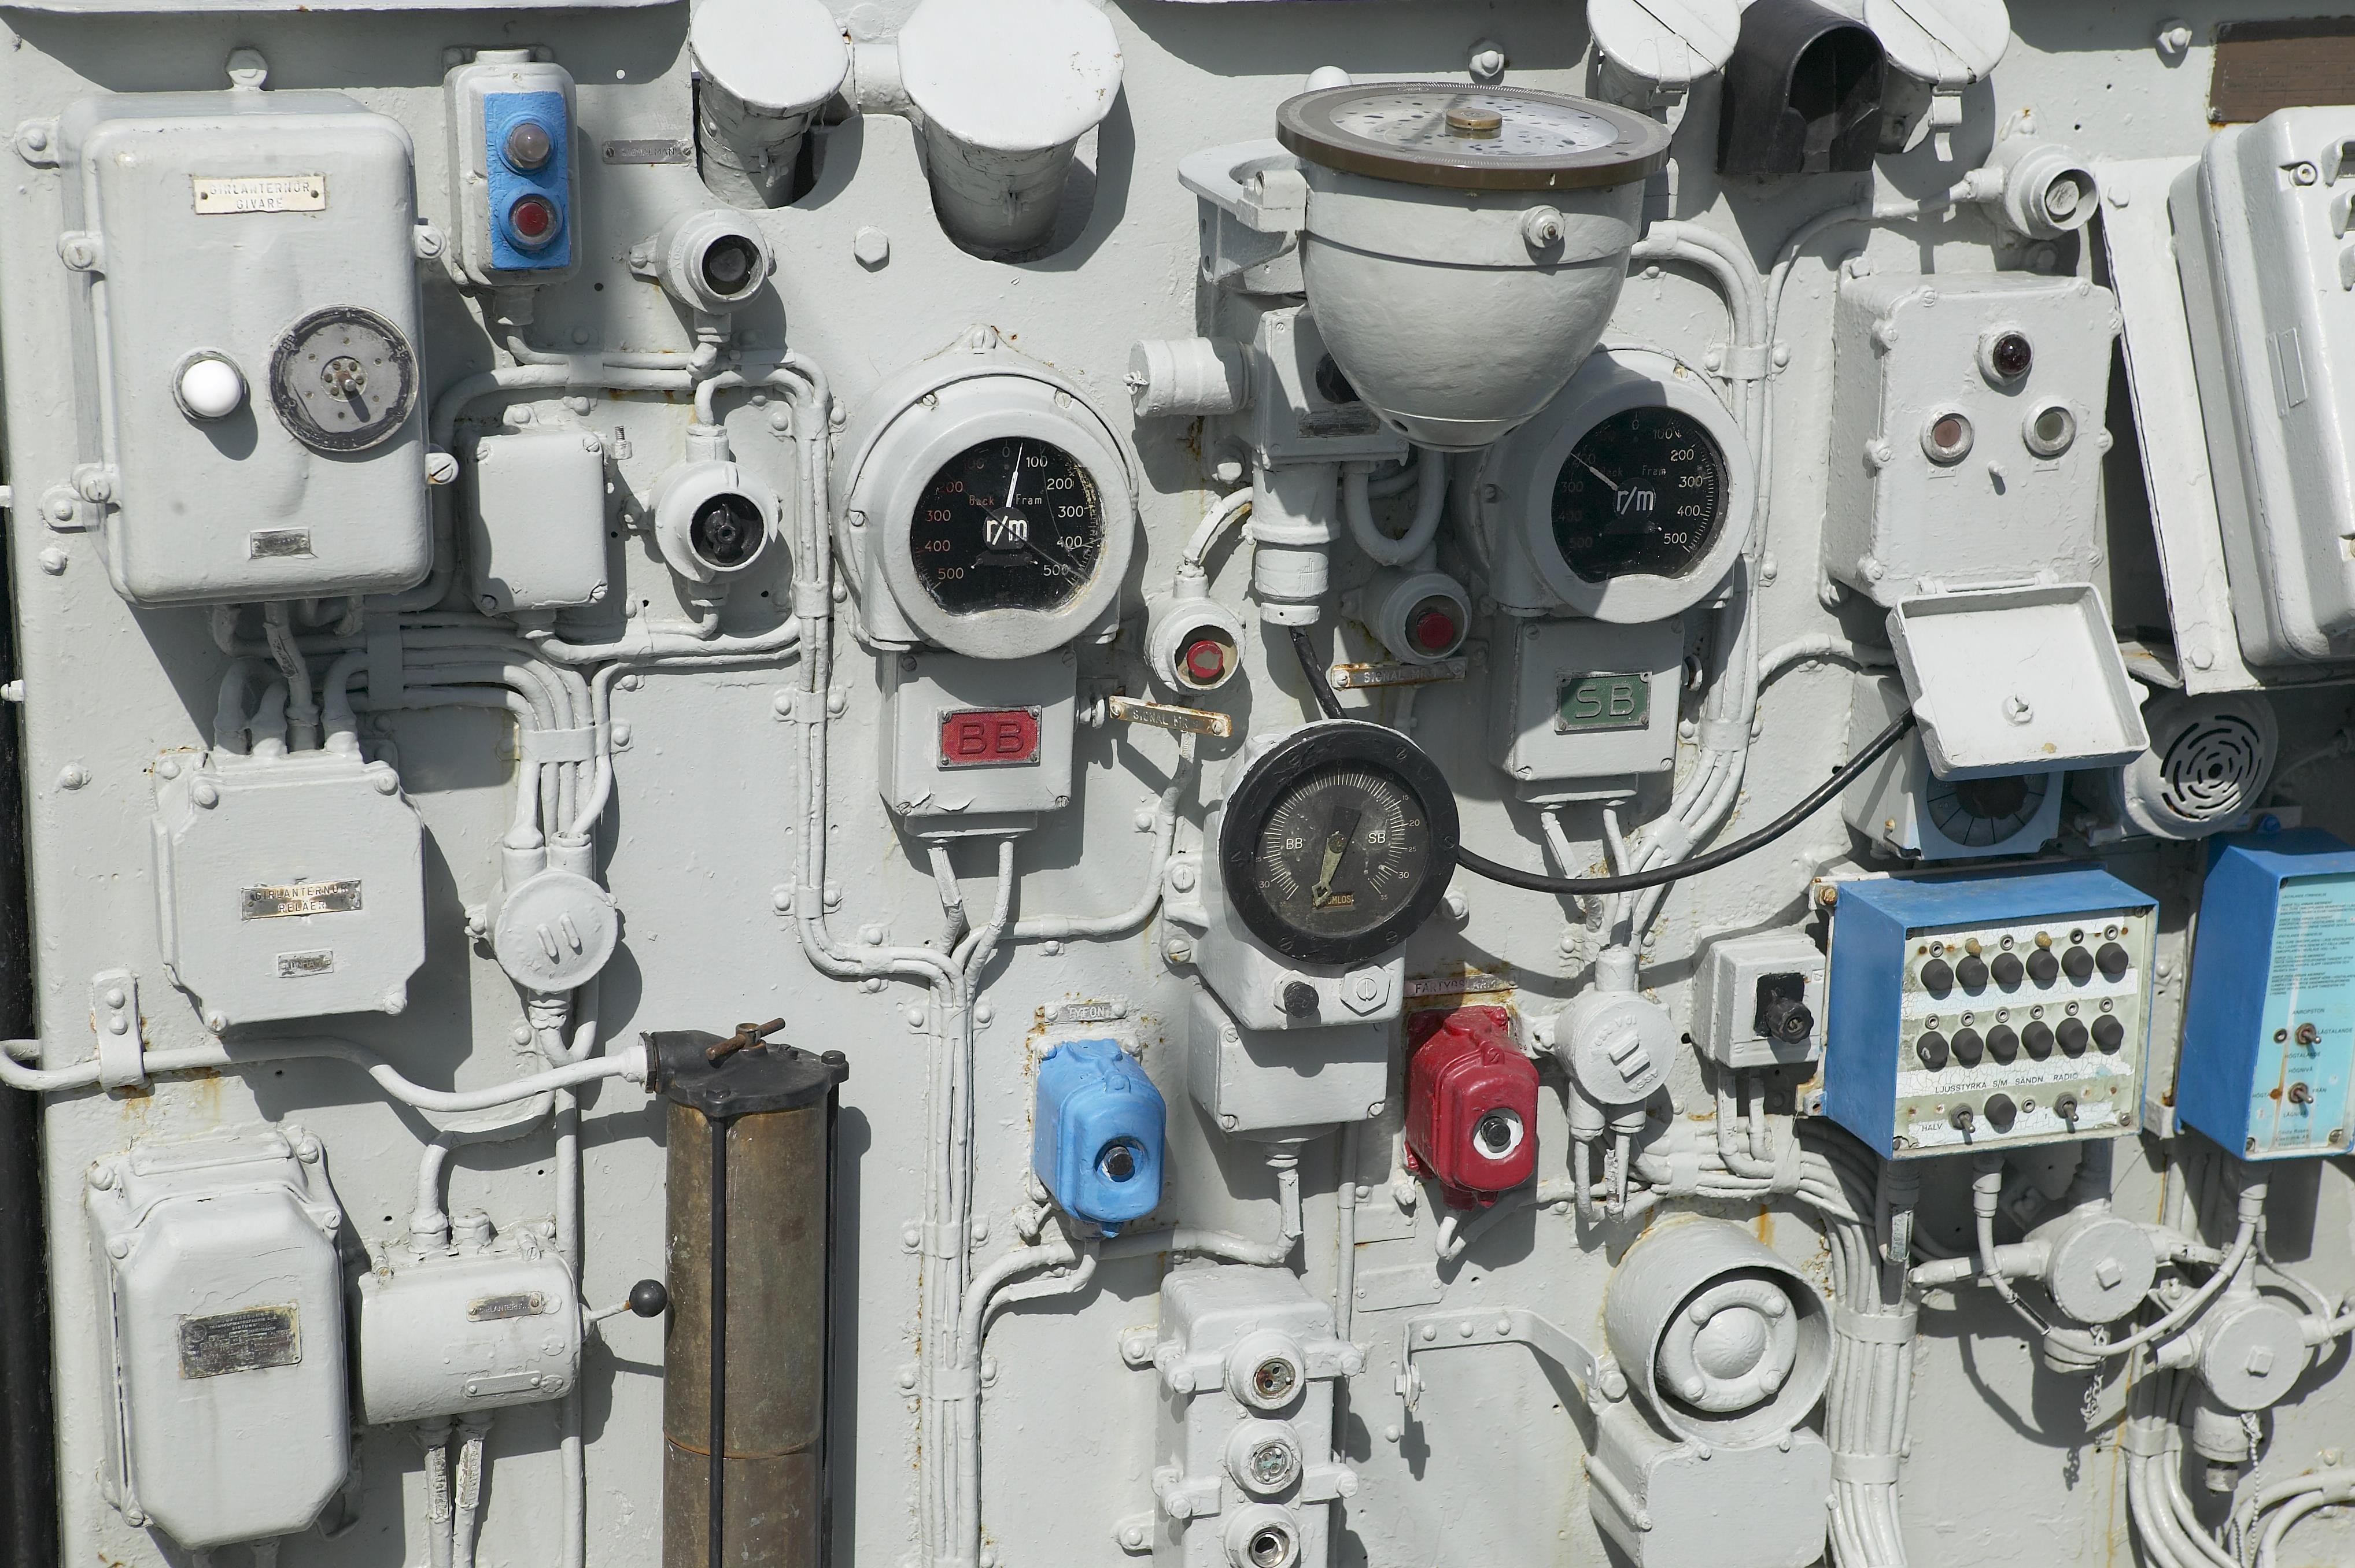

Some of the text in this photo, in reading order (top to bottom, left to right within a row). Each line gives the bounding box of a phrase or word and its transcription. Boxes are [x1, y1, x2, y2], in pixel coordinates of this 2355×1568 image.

[621, 147, 675, 157] SIGNALMAN
[236, 198, 283, 209] GIVARE
[1632, 419, 1640, 431] 0
[1653, 427, 1673, 440] 100
[1002, 446, 1010, 458] 0
[1670, 449, 1695, 462] 200
[1025, 456, 1047, 468] 100
[1642, 465, 1666, 476] Fram
[1046, 478, 1073, 490] 200
[1678, 475, 1704, 489] 300
[1016, 494, 1042, 505] Fram
[1617, 486, 1654, 515] r/m
[925, 509, 951, 522] 300
[1057, 505, 1084, 518] 300
[1677, 504, 1701, 517] 400
[986, 515, 1028, 545] r/m
[1055, 535, 1083, 549] 400
[1663, 531, 1688, 545] 500
[925, 539, 951, 552] 400
[937, 567, 965, 580] 500
[1043, 563, 1069, 577] 500
[1364, 671, 1403, 683] SIGNAL
[1575, 682, 1635, 718] SB
[959, 720, 1024, 753] BB
[1409, 819, 1420, 827] 20
[1286, 838, 1303, 850] BB
[1368, 833, 1386, 844] SB
[1398, 871, 1410, 879] 30
[1258, 881, 1270, 889] 30
[278, 900, 326, 913] RELÄER
[1415, 979, 1497, 994] FARTYGSLARM
[1068, 1005, 1105, 1019] TYFON
[1935, 1082, 1987, 1094] LJUSSTYRKA
[1992, 1079, 2009, 1088] S/M
[2053, 1072, 2079, 1082] RADIO
[1921, 1123, 1943, 1132] HALV
